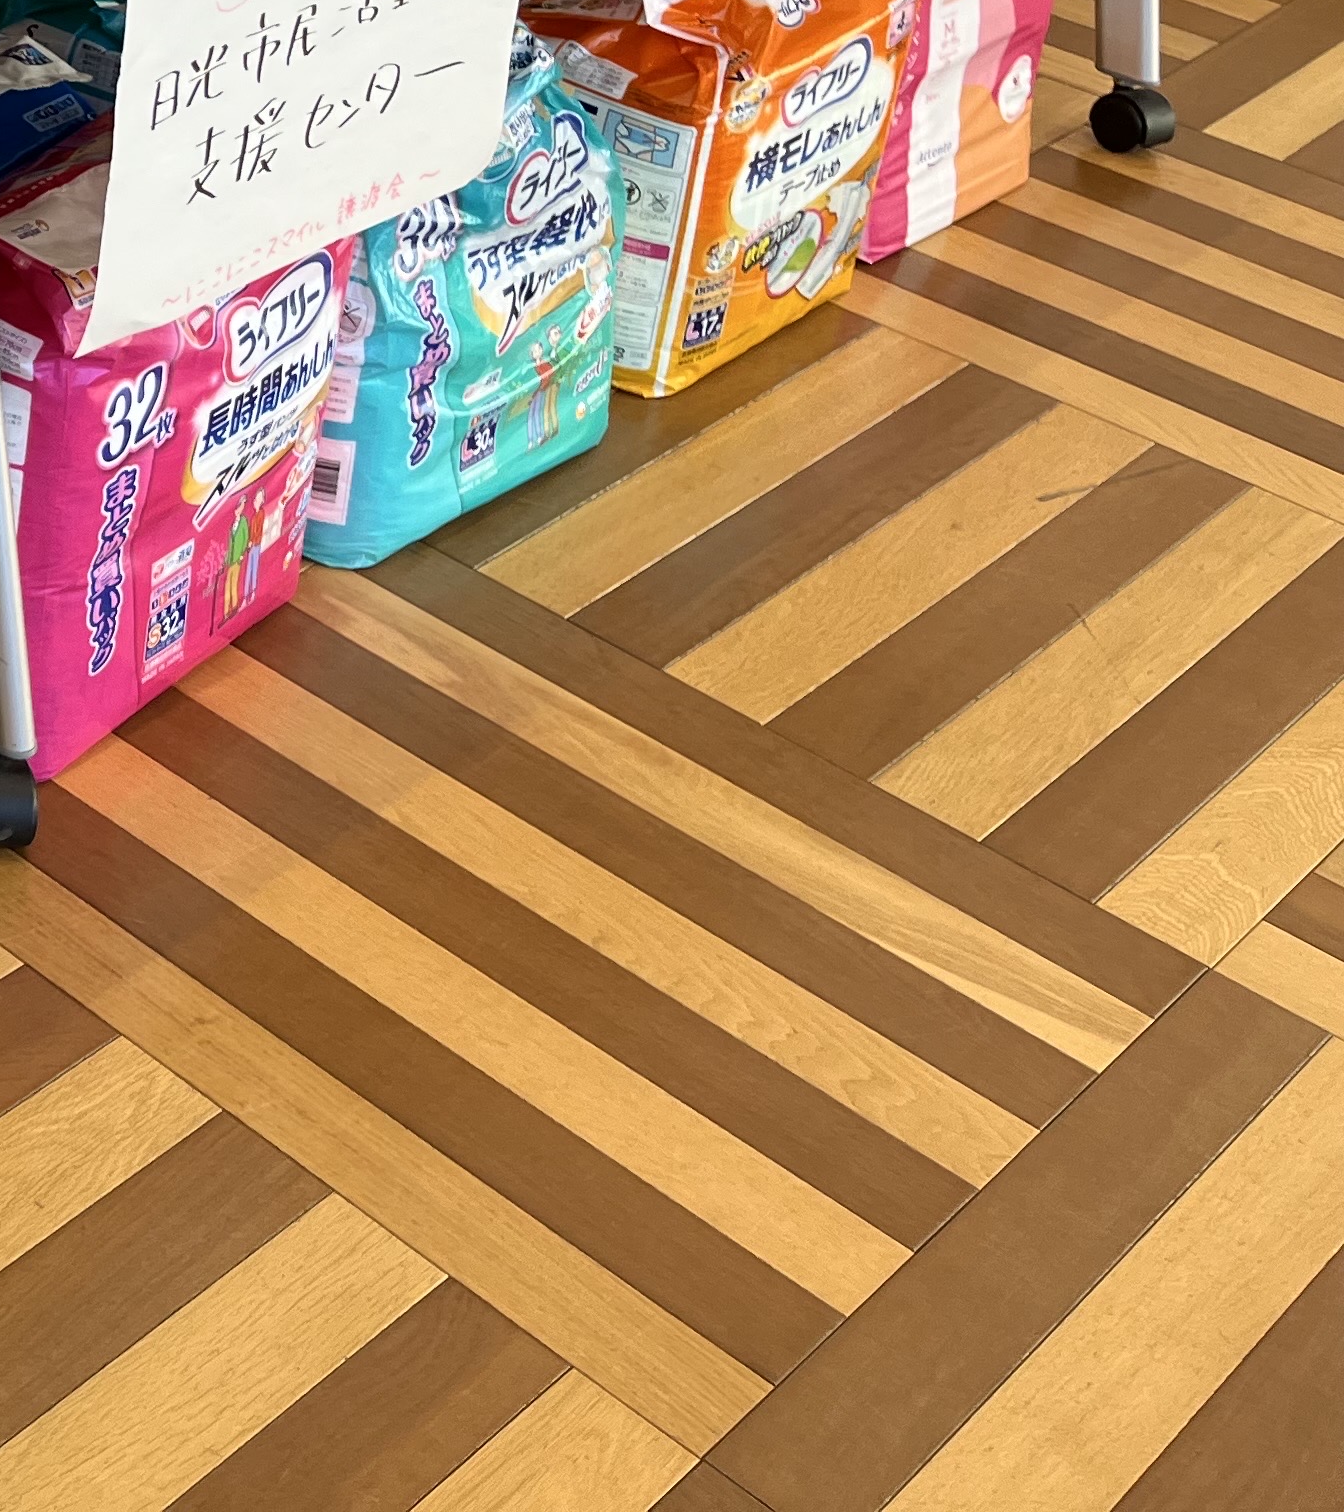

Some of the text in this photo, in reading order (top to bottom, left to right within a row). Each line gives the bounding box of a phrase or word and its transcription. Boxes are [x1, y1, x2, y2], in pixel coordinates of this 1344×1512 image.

[185, 60, 467, 206] 支援センター
[789, 58, 861, 115] ライフリー
[744, 96, 886, 194] 横モレあんしん
[778, 157, 842, 204] テープ止め
[236, 282, 320, 365] ライフリー
[101, 364, 176, 463] 32枚
[199, 333, 333, 459] 長時間あんしん
[89, 468, 138, 675] まとめ買いパック
